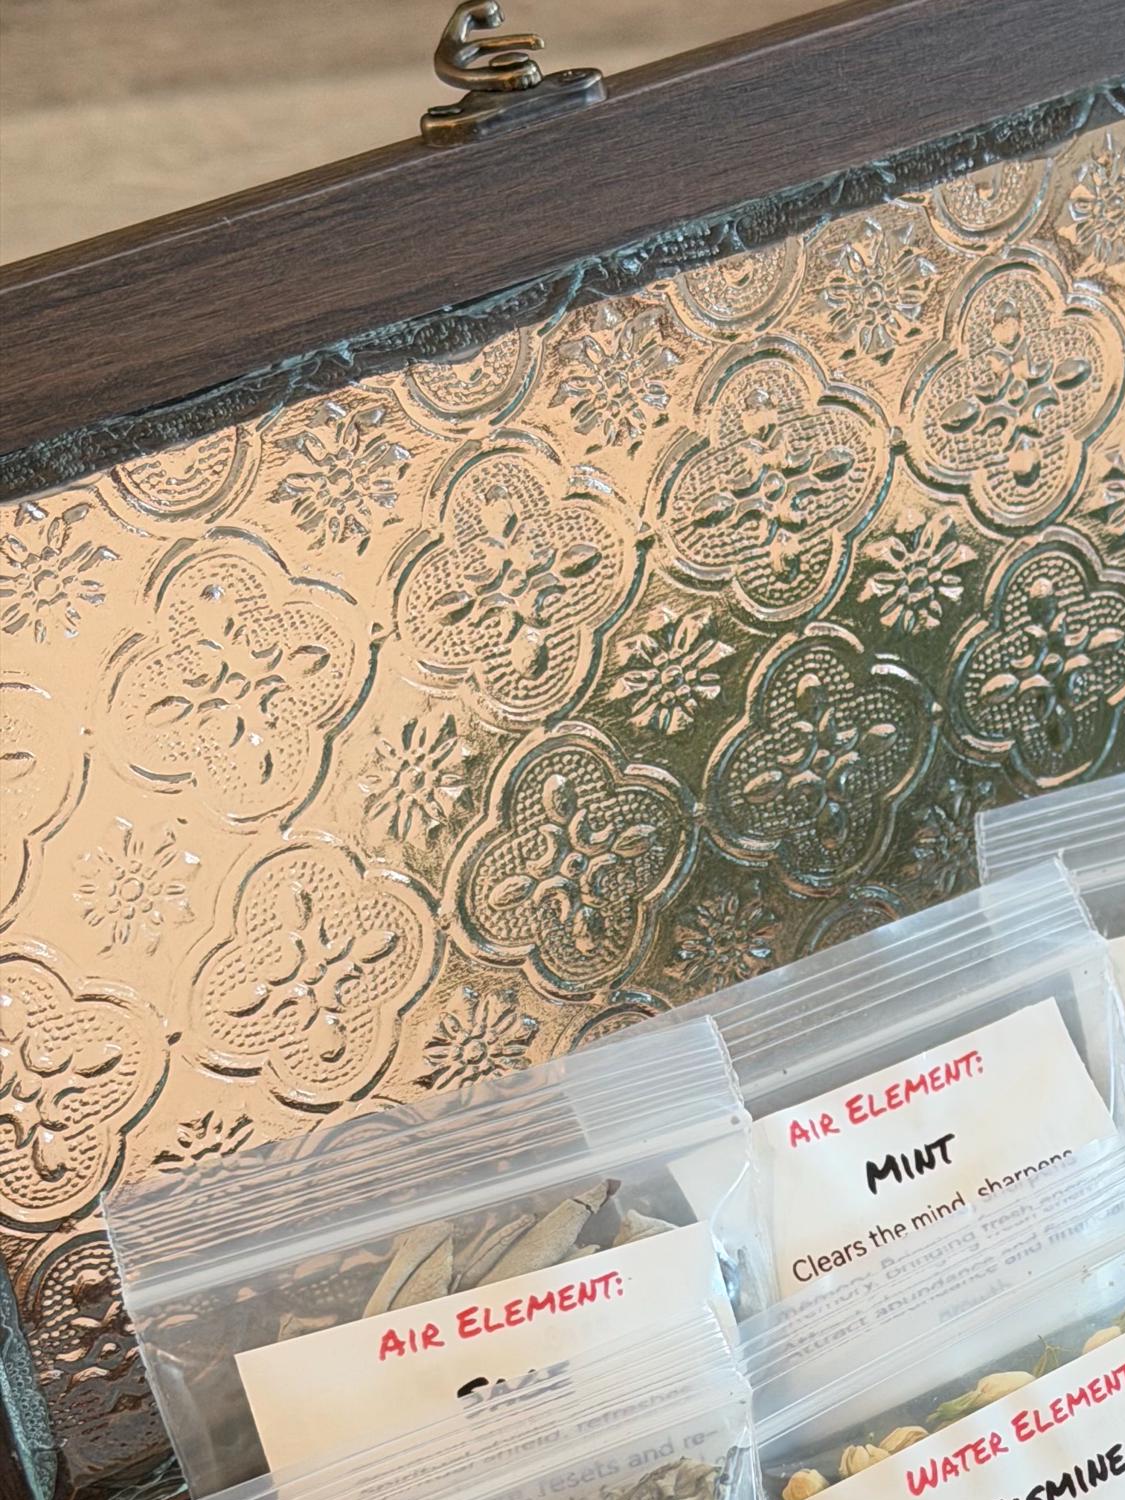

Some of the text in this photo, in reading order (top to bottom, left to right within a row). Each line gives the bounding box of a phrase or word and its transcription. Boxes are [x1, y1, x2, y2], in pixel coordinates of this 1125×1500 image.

[788, 1050, 985, 1148] AIR ELEMENT:
[865, 1133, 955, 1195] MINT
[792, 1237, 867, 1283] Clears
[868, 1220, 907, 1249] the
[378, 1271, 625, 1361] AIR ELEMENT:
[906, 1431, 1010, 1496] WATER
